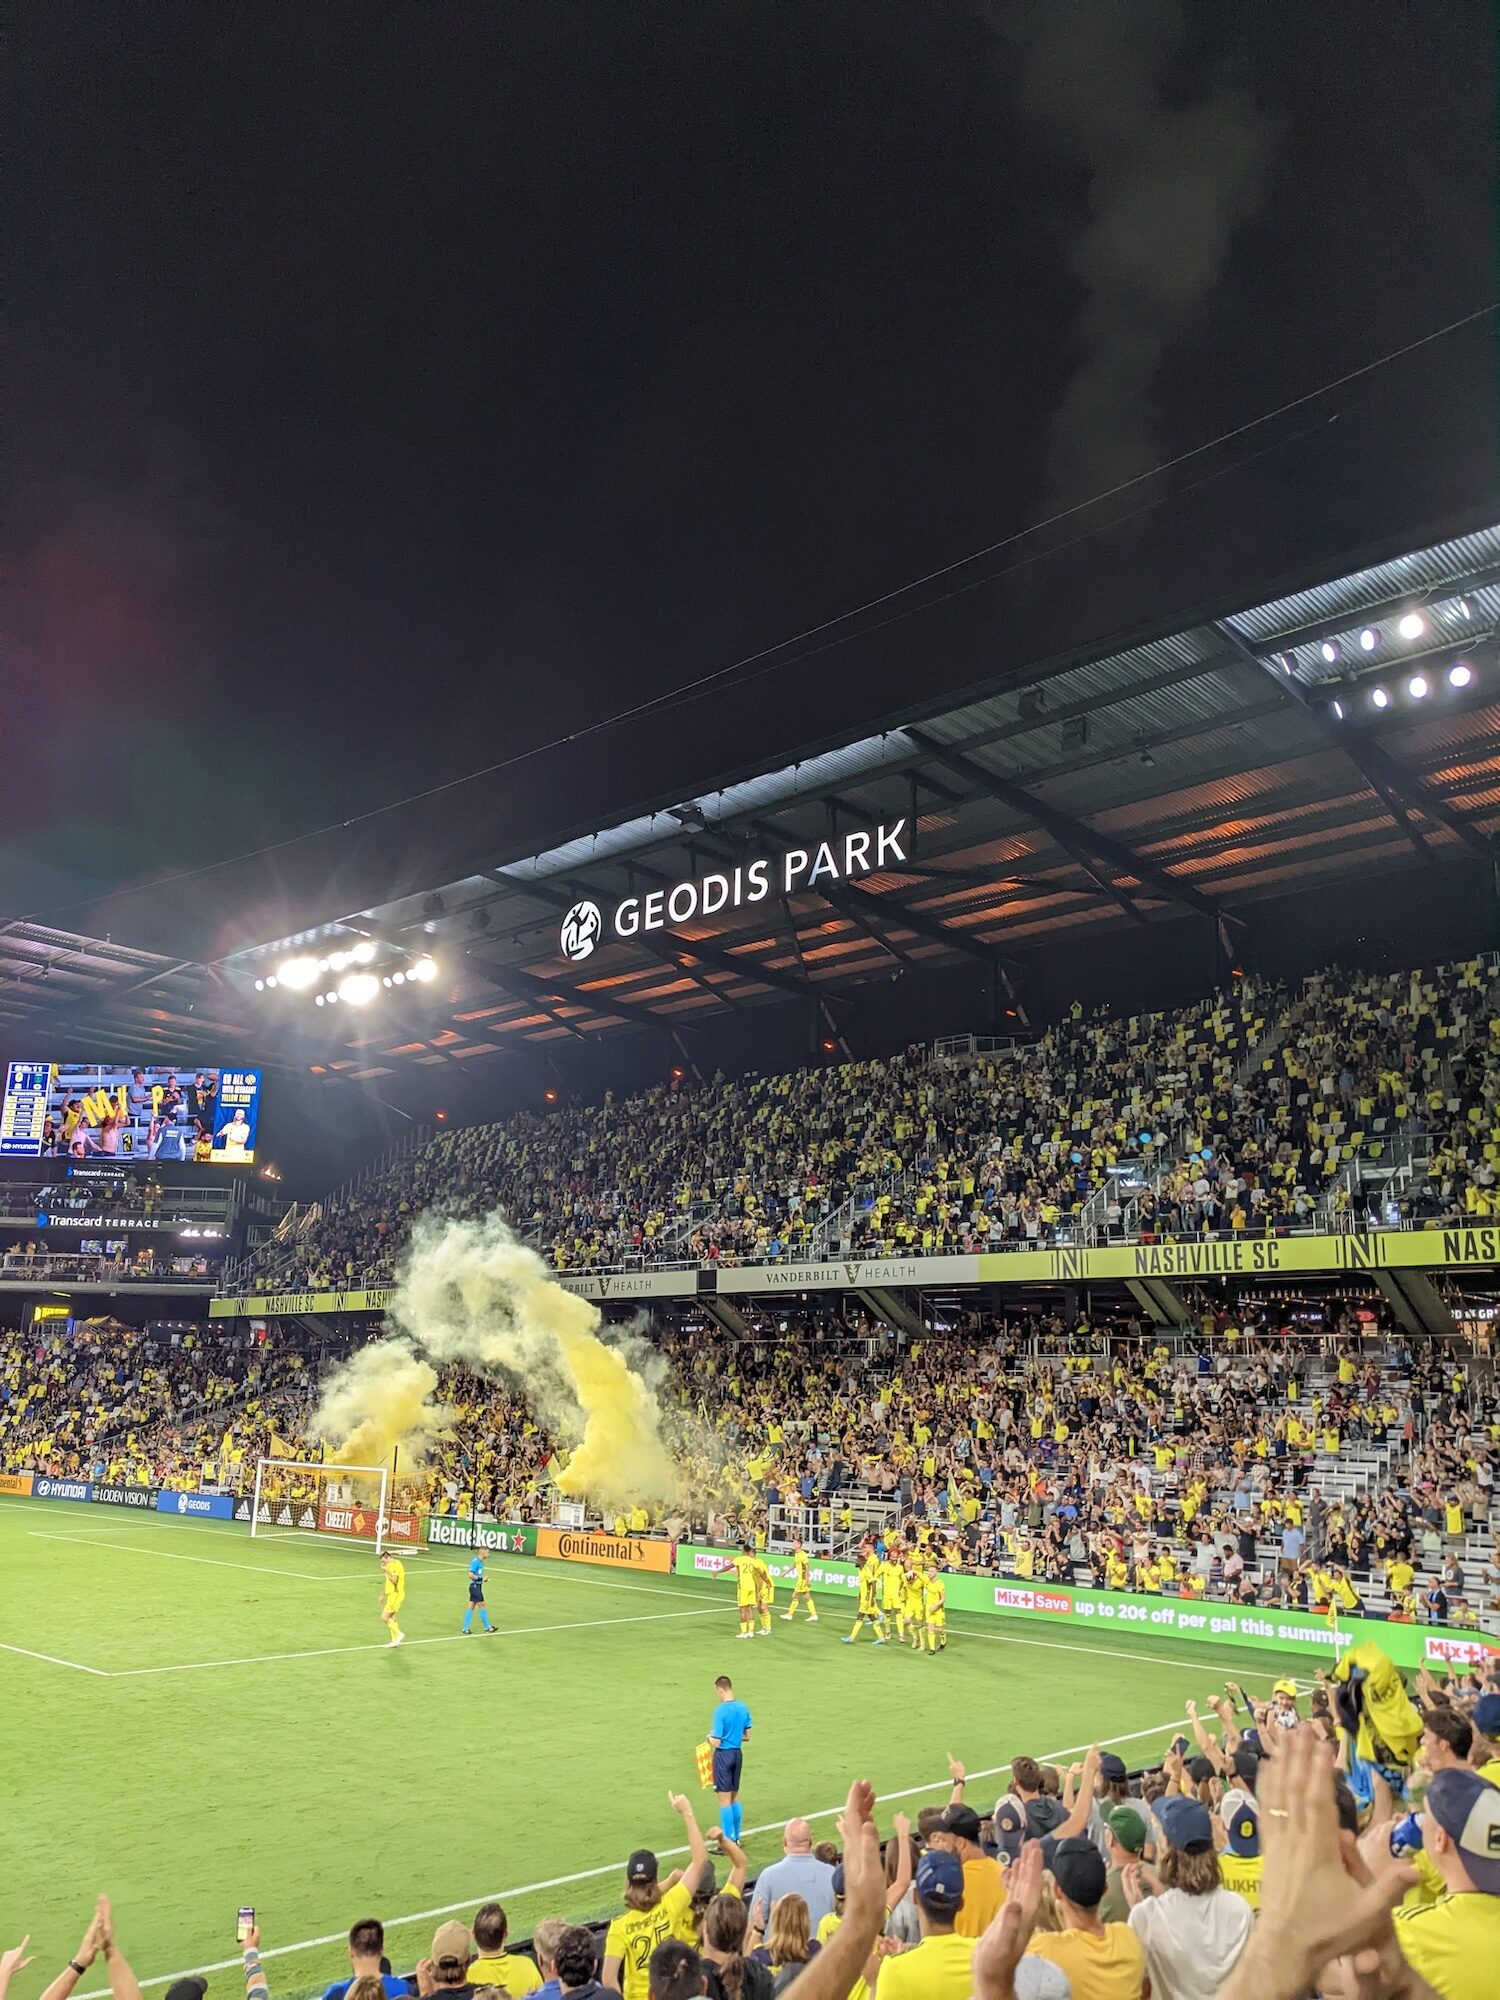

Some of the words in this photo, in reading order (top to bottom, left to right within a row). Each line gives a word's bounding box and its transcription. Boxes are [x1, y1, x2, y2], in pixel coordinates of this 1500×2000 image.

[615, 859, 769, 937] GEODIS
[784, 818, 906, 892] PARK
[73, 1168, 101, 1177] Transcard
[49, 1214, 103, 1227] Transcard
[105, 1219, 159, 1228] TERRACE
[1134, 1242, 1243, 1275] NASHVILLE
[1253, 1240, 1280, 1270] SC
[766, 1268, 839, 1284] VANDERBILT
[865, 1265, 917, 1279] HEALTH
[613, 1280, 652, 1291] HEALTH
[265, 1296, 303, 1313] NASHVILLE
[305, 1296, 315, 1311] SC
[51, 1483, 87, 1499] HYUNDAI
[100, 1489, 124, 1503] LODEN
[124, 1491, 149, 1506] VISION
[188, 1499, 211, 1511] GEODIS
[235, 1512, 251, 1521] adidas
[276, 1517, 294, 1526] adidas
[298, 1520, 315, 1529] adidas
[428, 1518, 507, 1550] Heineken
[558, 1533, 632, 1560] Continental
[768, 1563, 780, 1576] to
[825, 1572, 846, 1585] per
[1075, 1601, 1094, 1616] up
[1098, 1602, 1115, 1617] to
[1118, 1604, 1148, 1621] 20¢
[1151, 1608, 1175, 1624] off
[1178, 1612, 1206, 1629] per
[1210, 1616, 1237, 1633] gal
[1240, 1618, 1274, 1637] this
[1278, 1624, 1353, 1646] summer
